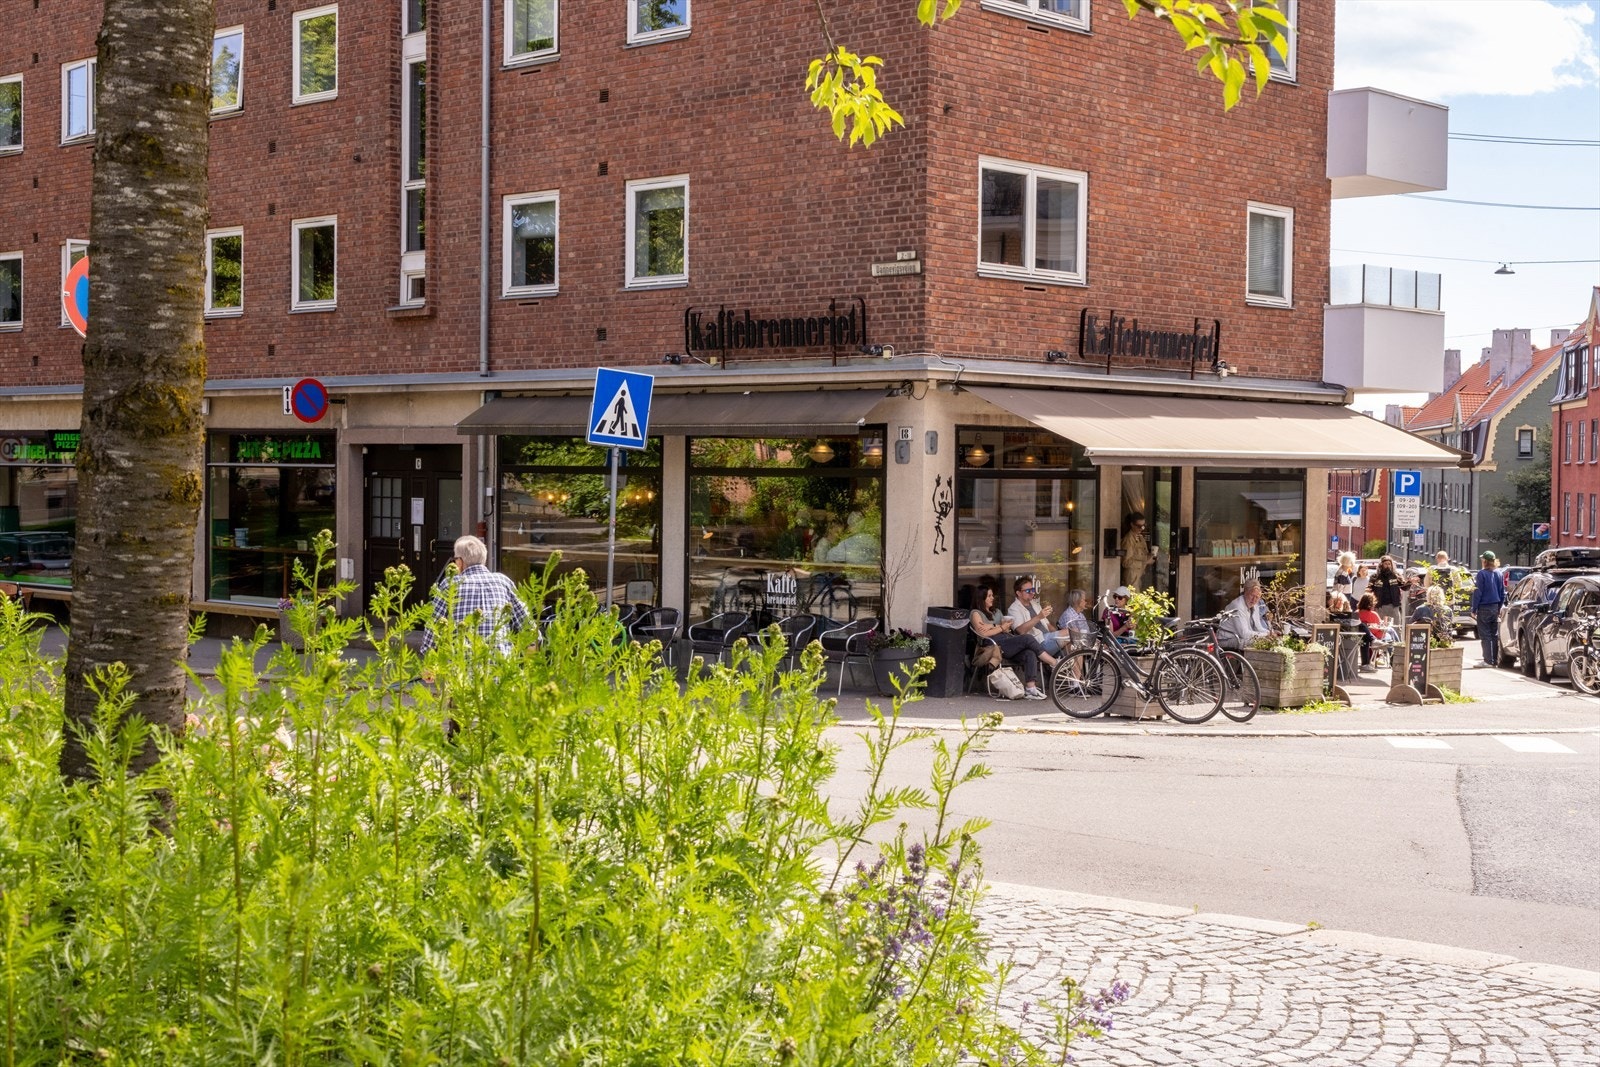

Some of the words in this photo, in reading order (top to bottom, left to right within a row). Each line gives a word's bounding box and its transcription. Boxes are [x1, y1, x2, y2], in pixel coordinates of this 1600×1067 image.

[689, 303, 861, 350] Kaffebrenneriet
[1086, 314, 1214, 362] Kaffebrenneriet
[901, 428, 909, 439] 18
[1401, 474, 1415, 493] P
[1346, 499, 1356, 513] P
[766, 573, 797, 594] Kaffe
[766, 593, 797, 606] brenneriet
